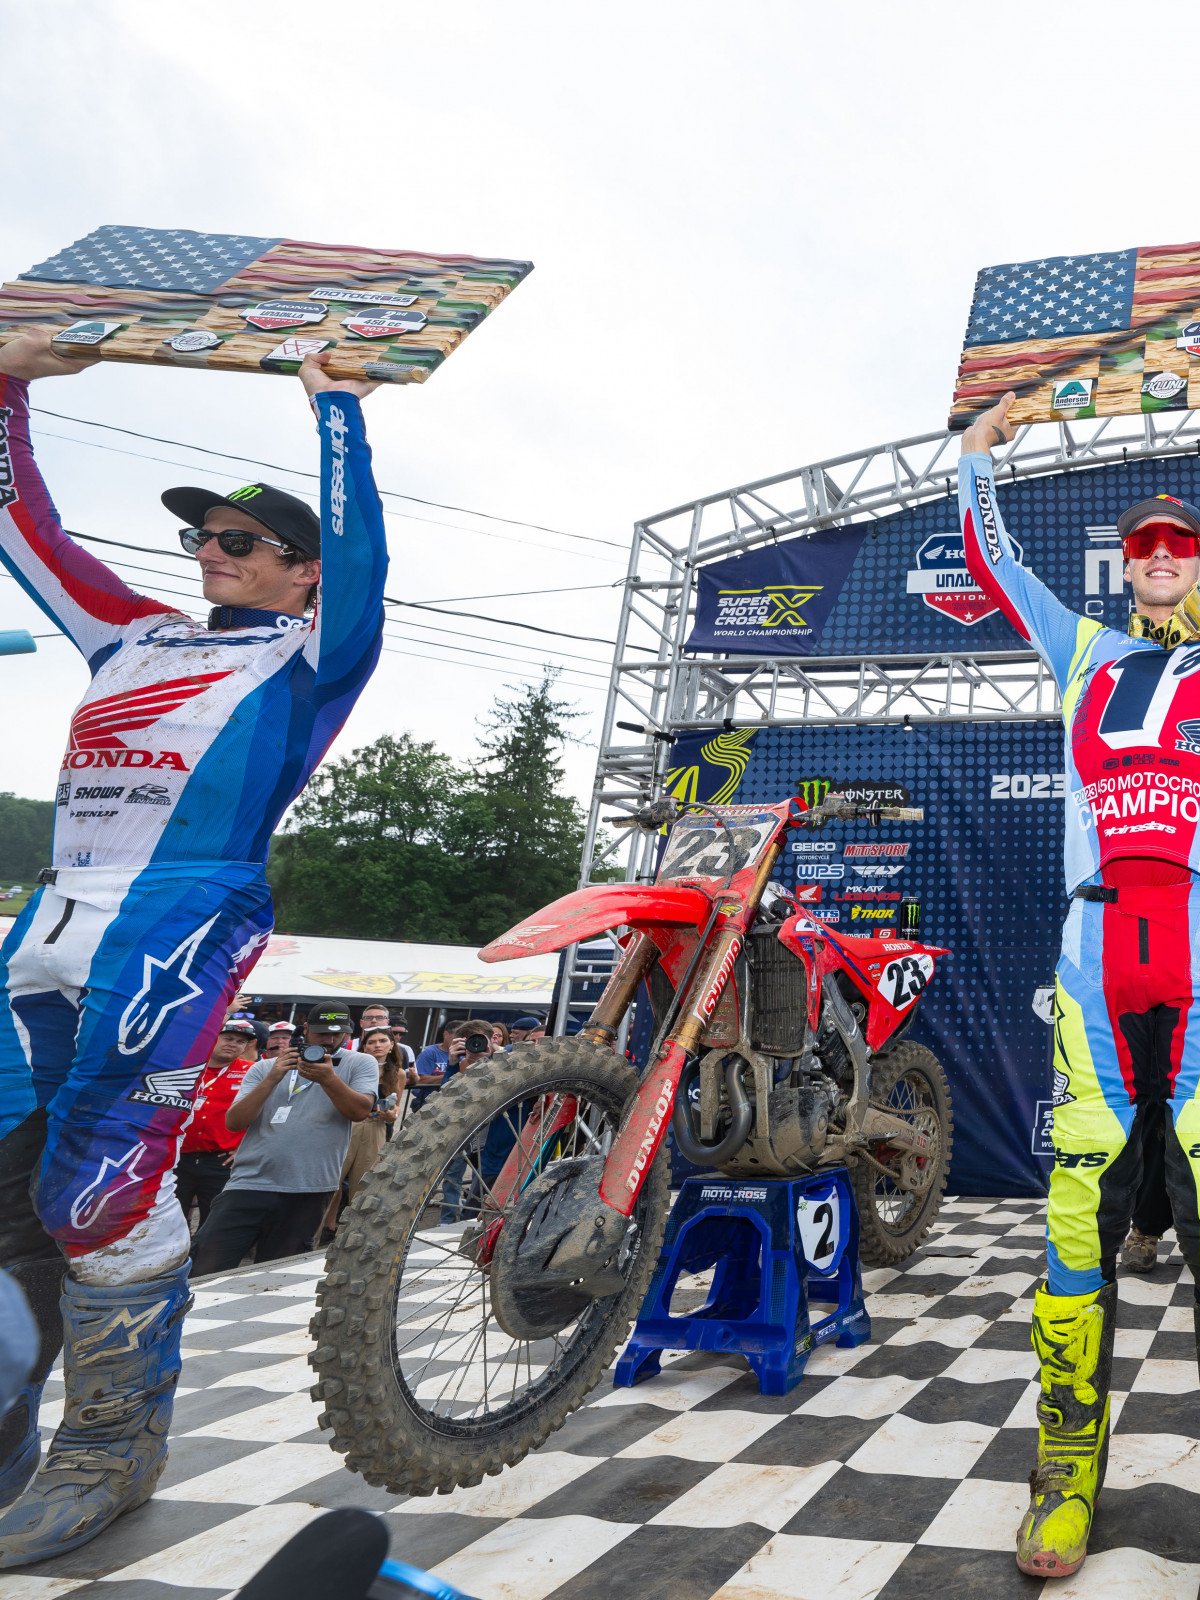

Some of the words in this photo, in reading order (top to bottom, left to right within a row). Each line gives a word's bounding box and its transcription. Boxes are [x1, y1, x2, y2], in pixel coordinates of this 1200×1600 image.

[313, 288, 413, 304] MOTOCROSS
[276, 302, 320, 312] HONDA
[260, 309, 304, 319] UNADILLA
[363, 318, 386, 327] 450
[361, 325, 390, 333] 2023
[60, 332, 101, 341] Anderson
[1141, 378, 1188, 393] EKLUND
[1055, 396, 1089, 405] Anderson
[325, 404, 349, 537] alpinestars
[975, 475, 1004, 566] HONDA
[717, 596, 772, 608] SUPER
[934, 594, 990, 602] NATION
[719, 606, 768, 617] MOTO
[714, 616, 769, 627] CROSS
[713, 629, 745, 637] WORLD
[746, 627, 813, 637] CHAMPIONSHIP
[60, 750, 191, 772] HONDA
[73, 786, 125, 799] SHOWA
[990, 774, 1066, 800] 2023
[1074, 784, 1097, 803] 2023
[75, 810, 119, 818] DUNLOP
[791, 842, 836, 852] GEICO
[660, 828, 762, 879] 23
[797, 864, 845, 879] WPS
[853, 865, 905, 876] FLY
[845, 885, 885, 893] MX-ATV
[834, 892, 902, 902] LEGENDS
[861, 909, 896, 919] THOR
[882, 943, 914, 952] HONDA
[887, 956, 928, 1009] 23
[627, 1078, 678, 1193] DUNLOP
[700, 1188, 768, 1200] MOTOCROSS
[812, 1203, 835, 1261] 2
